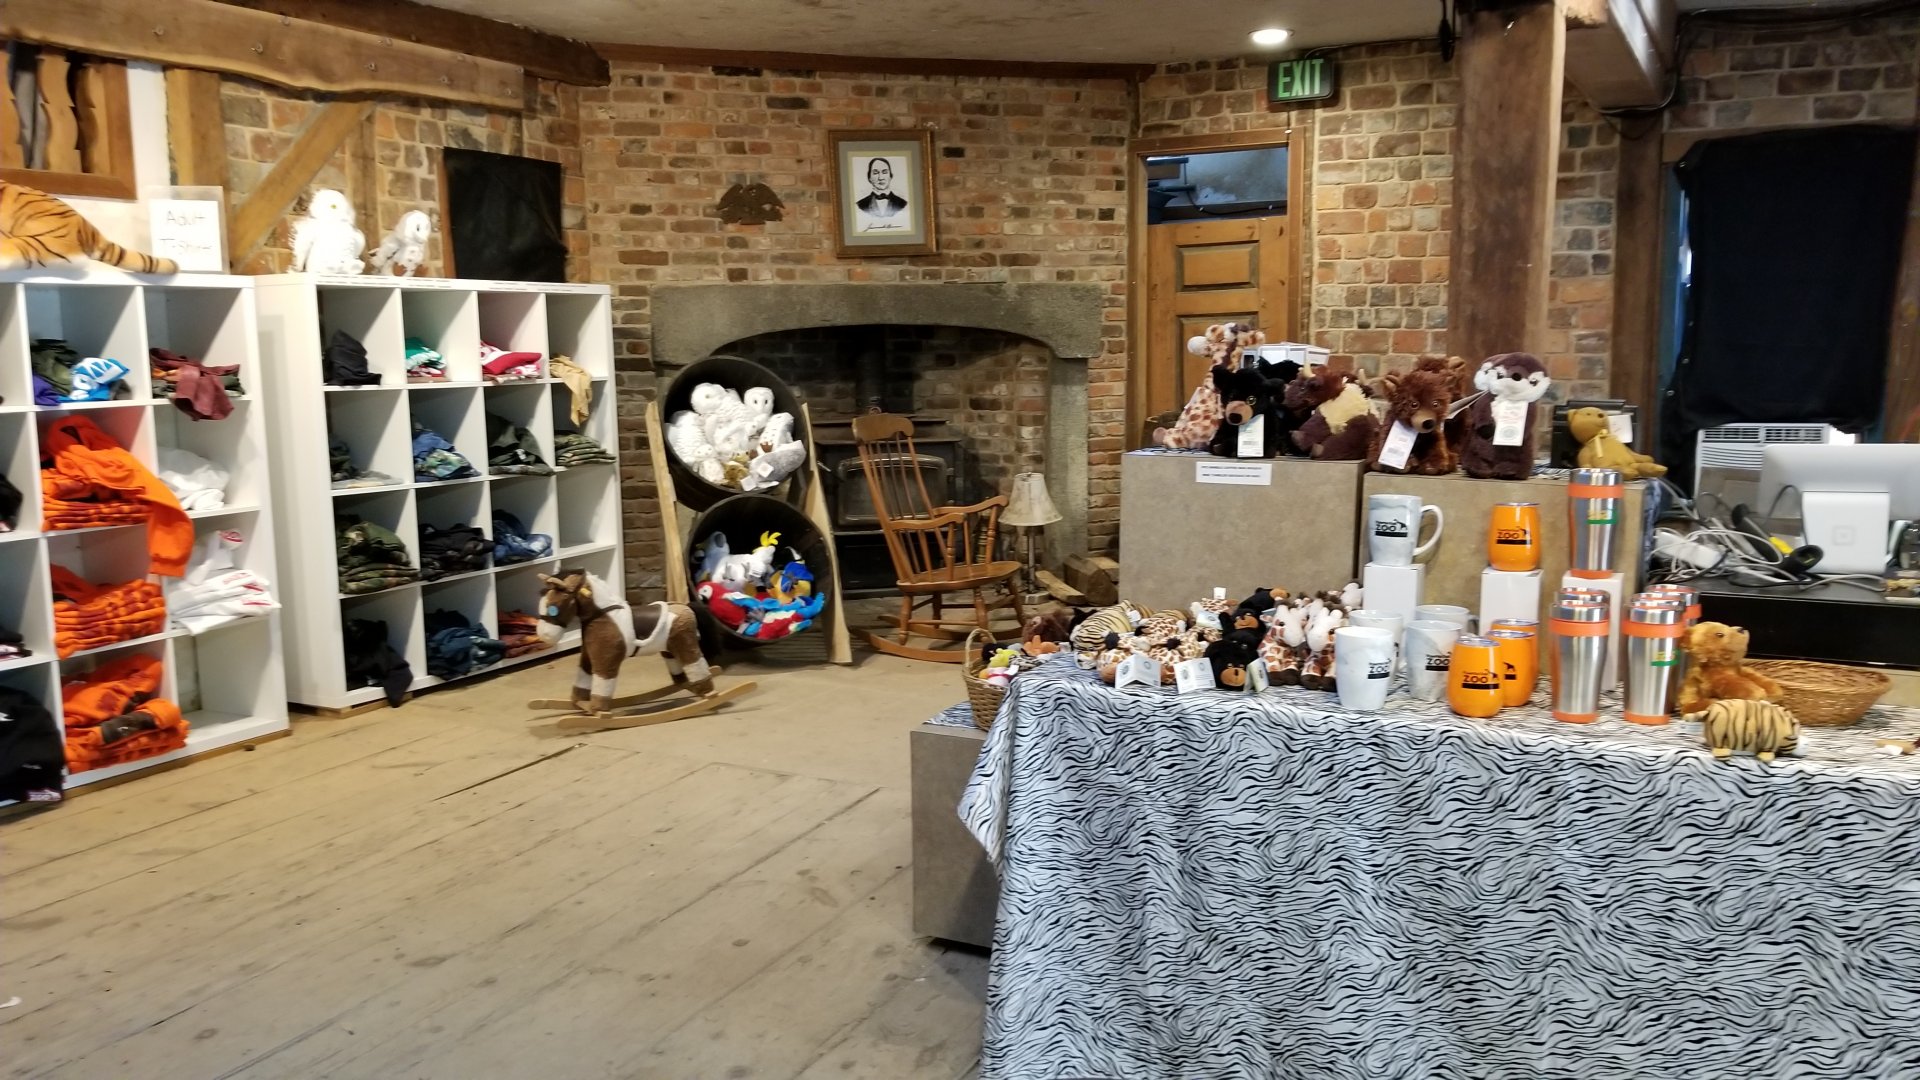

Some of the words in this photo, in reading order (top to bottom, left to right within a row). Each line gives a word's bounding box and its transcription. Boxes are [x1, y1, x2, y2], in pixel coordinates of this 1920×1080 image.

[1278, 58, 1324, 97] EXIT
[1375, 524, 1397, 532] ZOO
[1496, 531, 1520, 540] ZOO
[1463, 674, 1488, 684] ZOO
